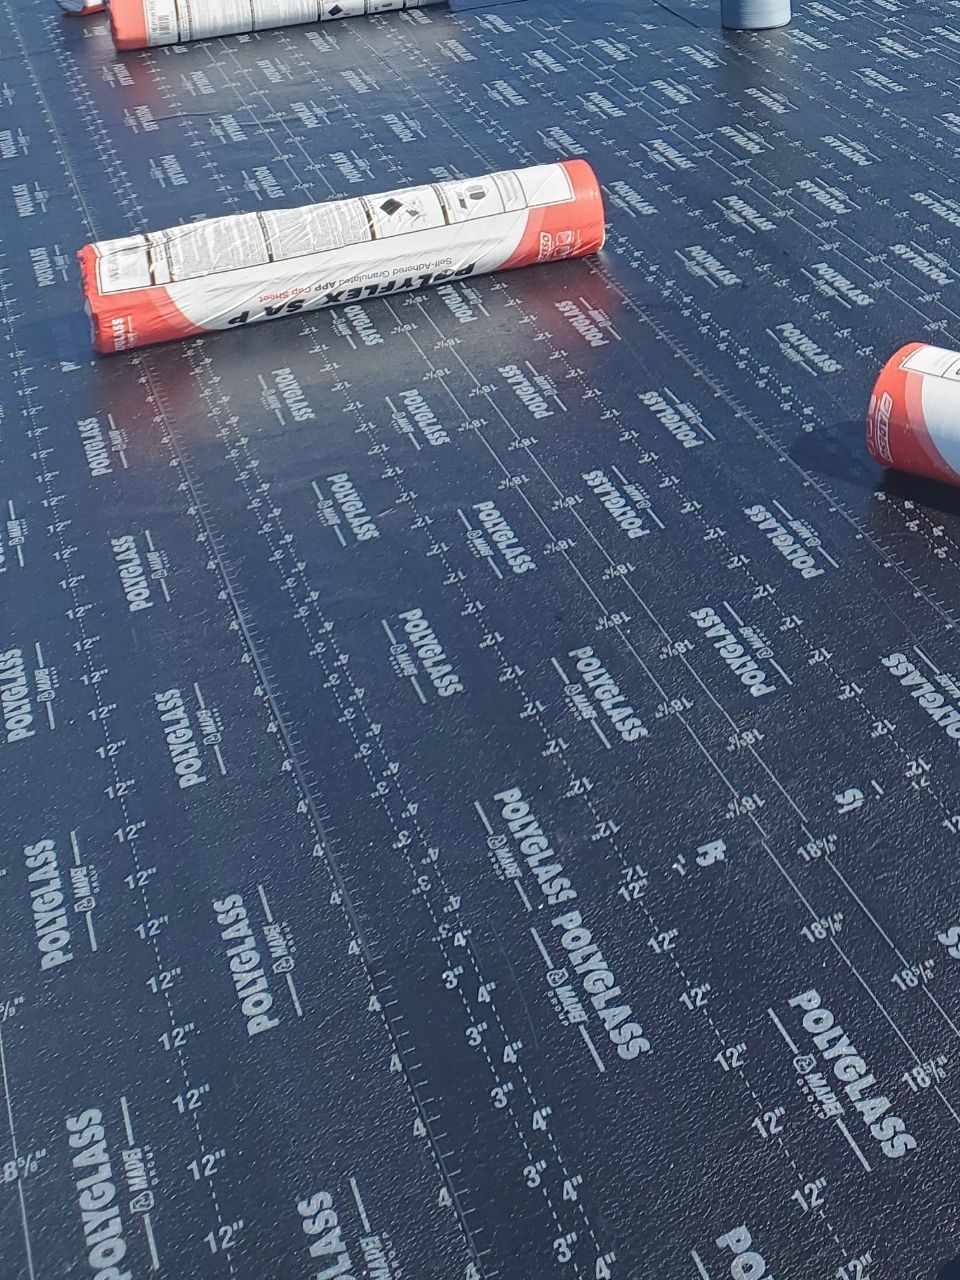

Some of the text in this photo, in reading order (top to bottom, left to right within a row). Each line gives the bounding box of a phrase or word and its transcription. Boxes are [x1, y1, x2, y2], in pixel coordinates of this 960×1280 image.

[227, 311, 249, 327] P
[265, 299, 306, 318] SA
[314, 282, 336, 292] APP
[343, 304, 385, 346] OLYGLASS
[555, 300, 610, 347] POLYGLASS
[776, 322, 844, 372] POLYGLASS
[271, 368, 316, 422] POLYGLASS
[399, 389, 452, 446] POLYGLASS
[499, 364, 553, 420] POLYGLASS
[639, 391, 705, 448] POLYGLASS
[79, 417, 112, 477] POLYGLASS
[327, 473, 380, 541] POLYGLASS
[472, 501, 536, 573] POLYGLASS
[582, 470, 650, 539] POLYGLASS
[111, 535, 154, 612] POLYGLASS
[744, 505, 825, 578] POLYGLASS
[399, 608, 464, 697] POLYGLASS
[691, 607, 776, 698] POLYGLASS
[0, 649, 35, 743] POLYGLASS
[569, 646, 650, 741] POLYGLASS
[155, 688, 206, 789] POLYGLASS
[494, 787, 578, 905] POLYGLASS
[24, 839, 73, 971] POLYGLASS
[213, 894, 280, 1036] POLYGLASS
[552, 910, 651, 1060] POLYGLASS
[787, 988, 918, 1159] POLYGLASS
[123, 1150, 149, 1192] MAPEI
